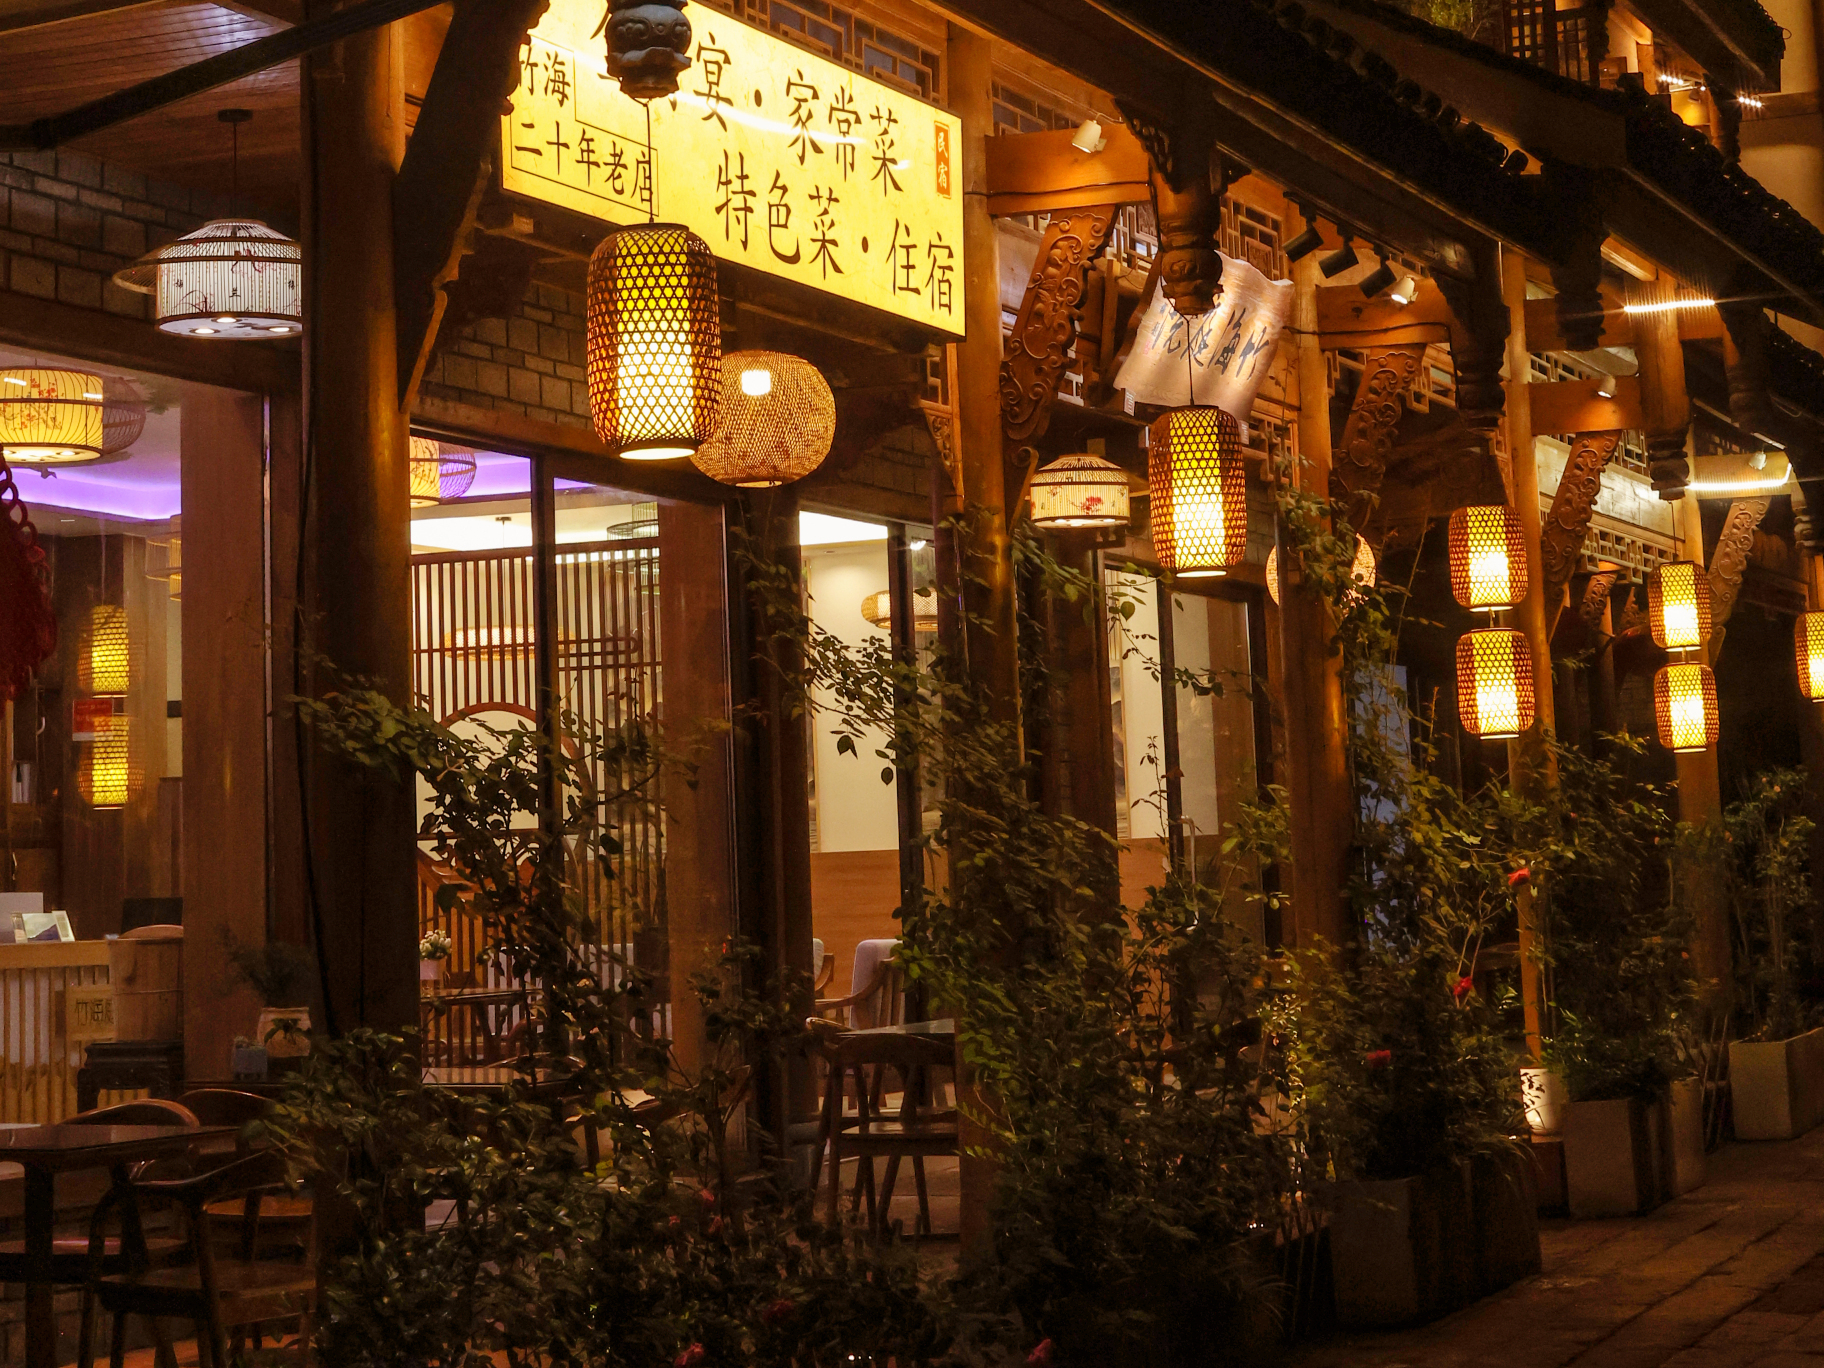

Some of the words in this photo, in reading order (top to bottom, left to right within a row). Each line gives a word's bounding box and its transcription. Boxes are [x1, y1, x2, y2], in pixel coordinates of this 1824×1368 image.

[519, 45, 571, 108] 竹海
[515, 120, 653, 204] 二十年老店
[937, 131, 949, 190] 民宿
[715, 149, 954, 317] 特色菜·住宿
